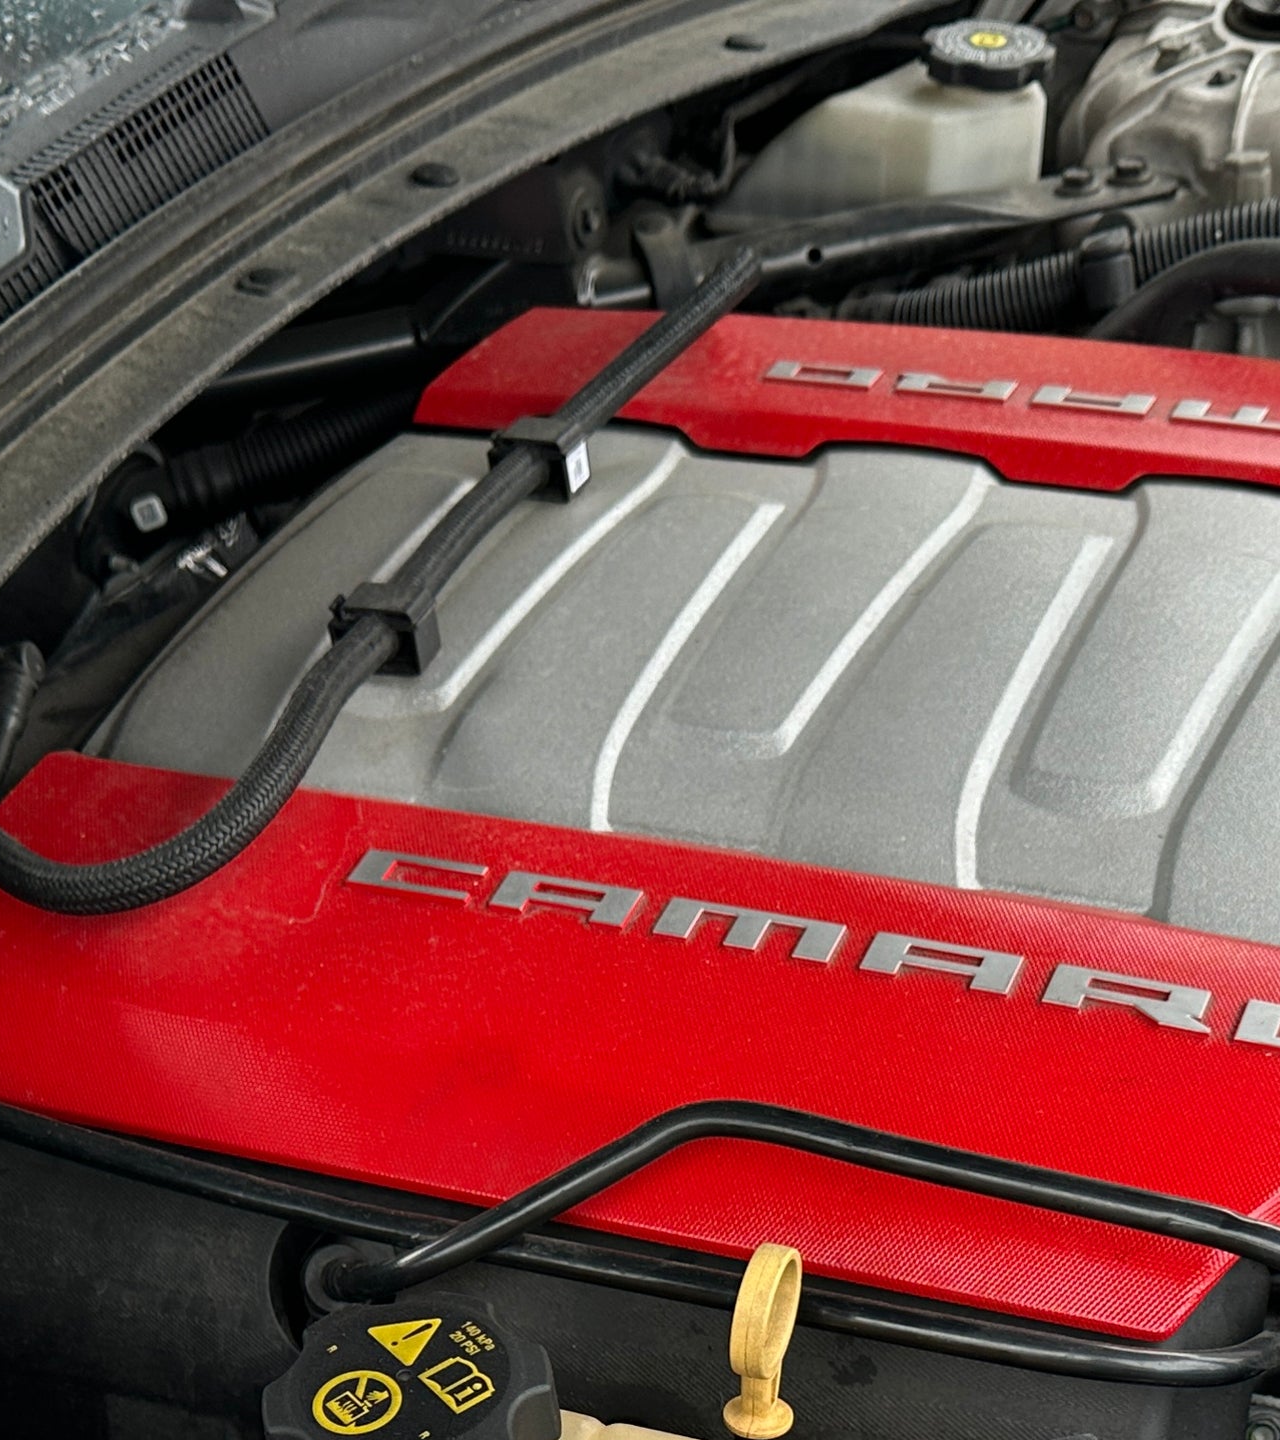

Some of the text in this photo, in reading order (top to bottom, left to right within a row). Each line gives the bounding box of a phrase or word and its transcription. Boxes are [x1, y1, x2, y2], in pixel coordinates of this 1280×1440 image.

[448, 1330, 482, 1356] 20 PSI
[461, 1321, 496, 1352] 140 kPa
